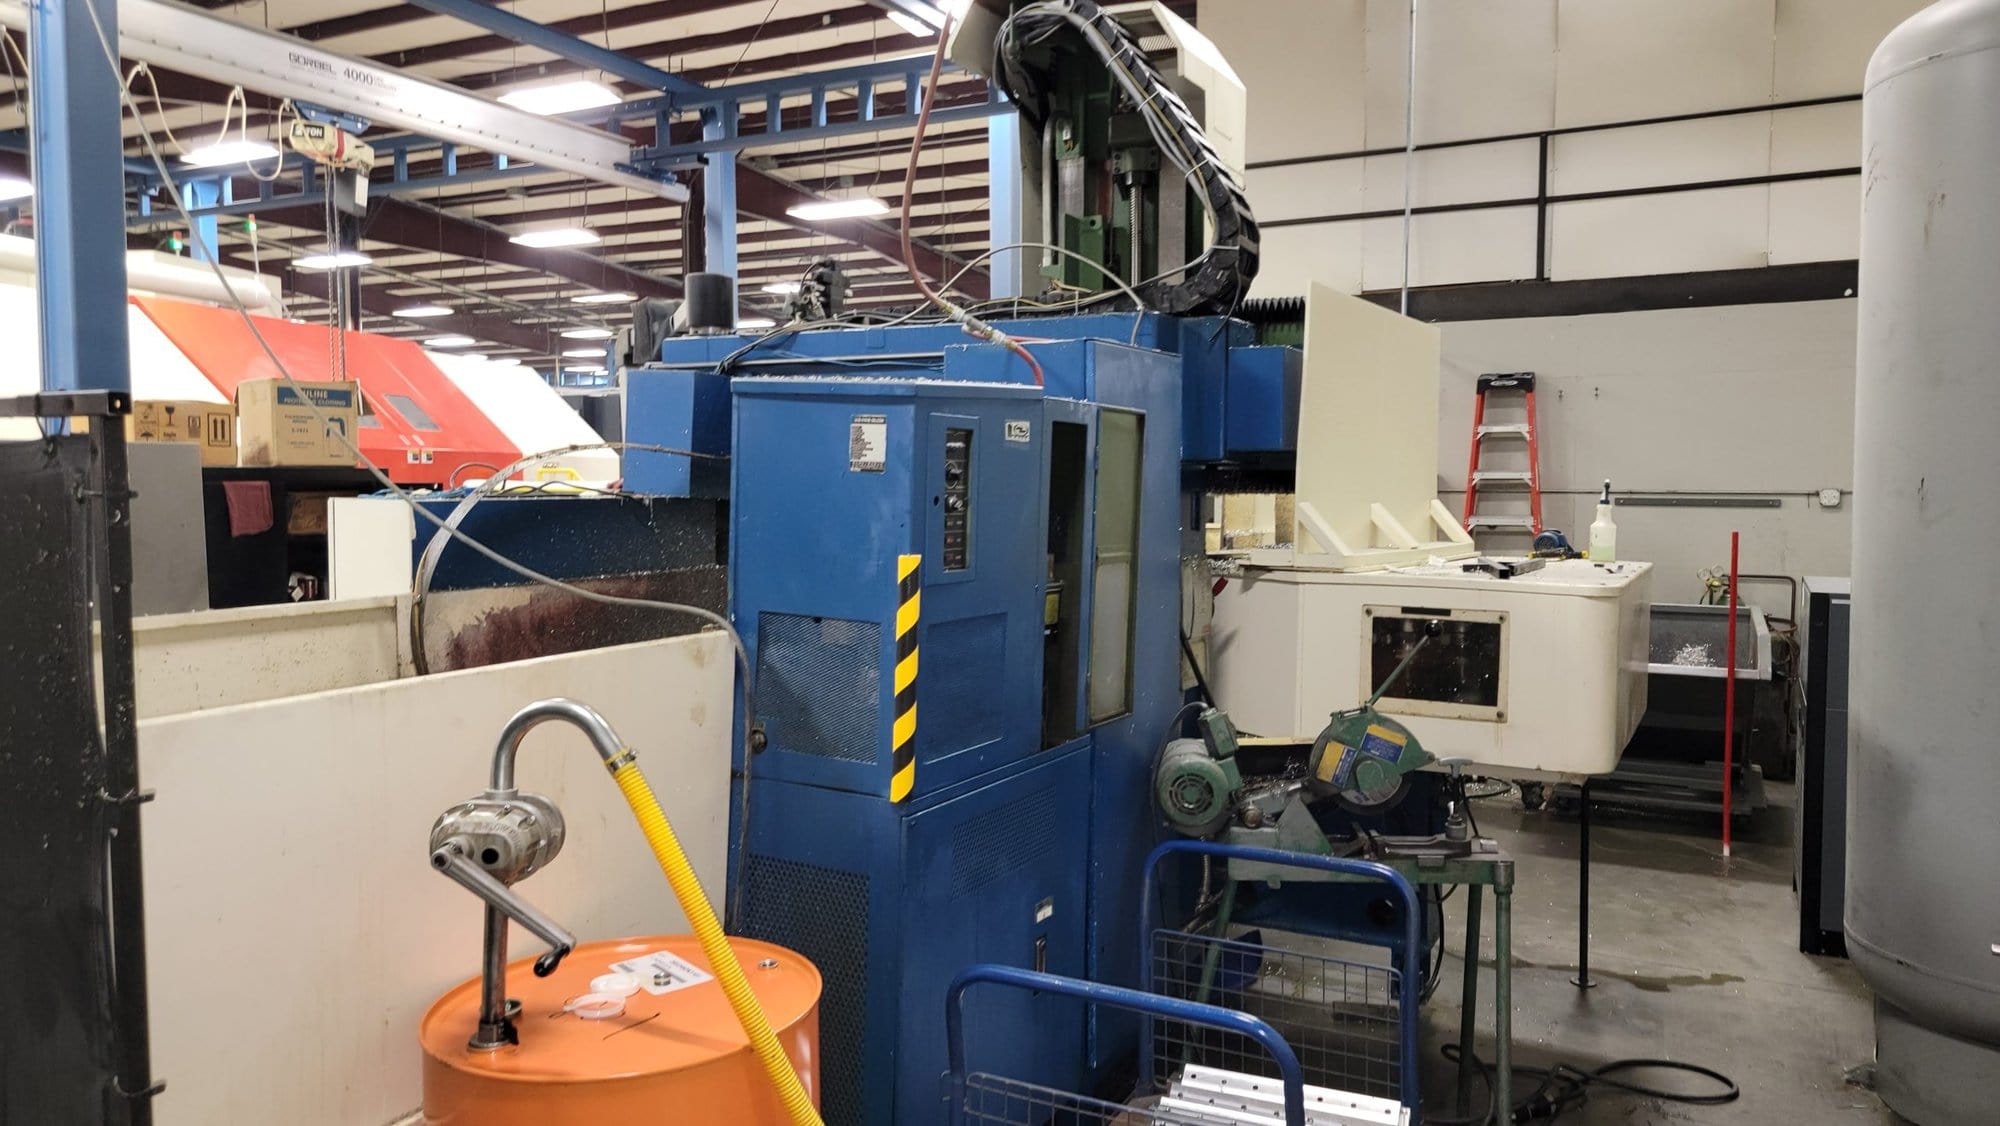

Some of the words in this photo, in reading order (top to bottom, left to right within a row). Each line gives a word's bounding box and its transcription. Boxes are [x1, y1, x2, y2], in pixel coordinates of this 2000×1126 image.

[289, 52, 333, 73] GORBEL
[343, 68, 374, 86] 4000
[302, 388, 329, 400] ULINE
